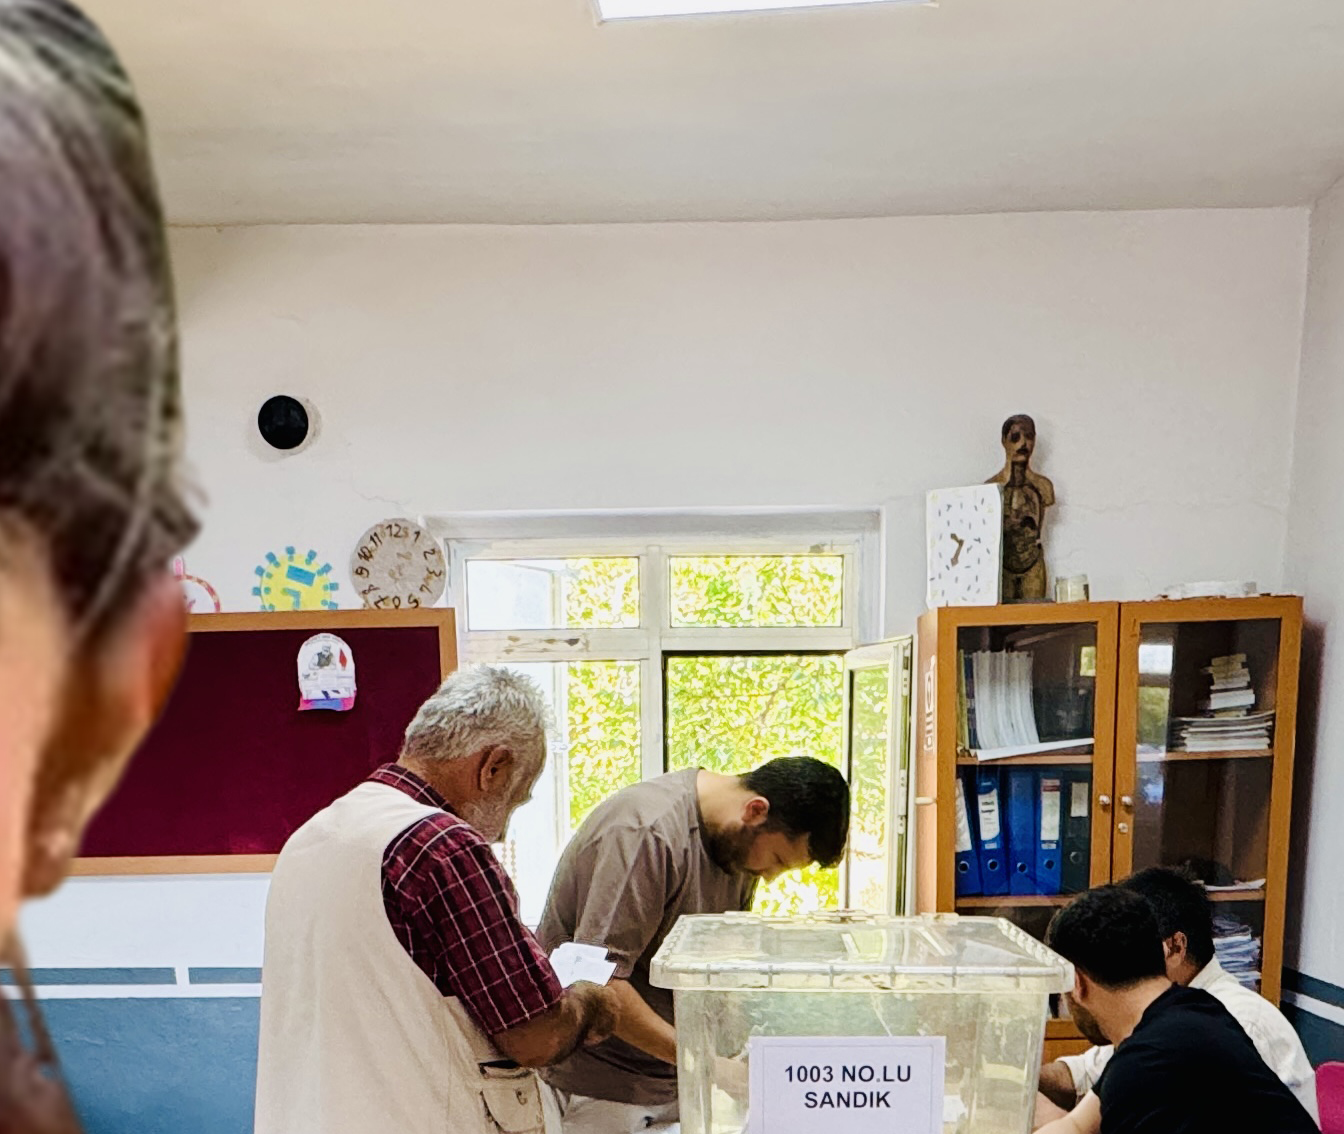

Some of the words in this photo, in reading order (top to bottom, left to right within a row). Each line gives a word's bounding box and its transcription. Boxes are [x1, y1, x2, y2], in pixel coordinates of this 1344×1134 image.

[386, 523, 403, 538] 12
[414, 530, 421, 543] 1
[369, 532, 383, 547] 11
[357, 546, 374, 562] 10
[423, 548, 436, 561] 2
[355, 566, 370, 578] 9
[426, 567, 443, 577] 3
[785, 1065, 834, 1083] 1003
[842, 1065, 912, 1083] NO.LU
[804, 1091, 892, 1109] SANDIK
